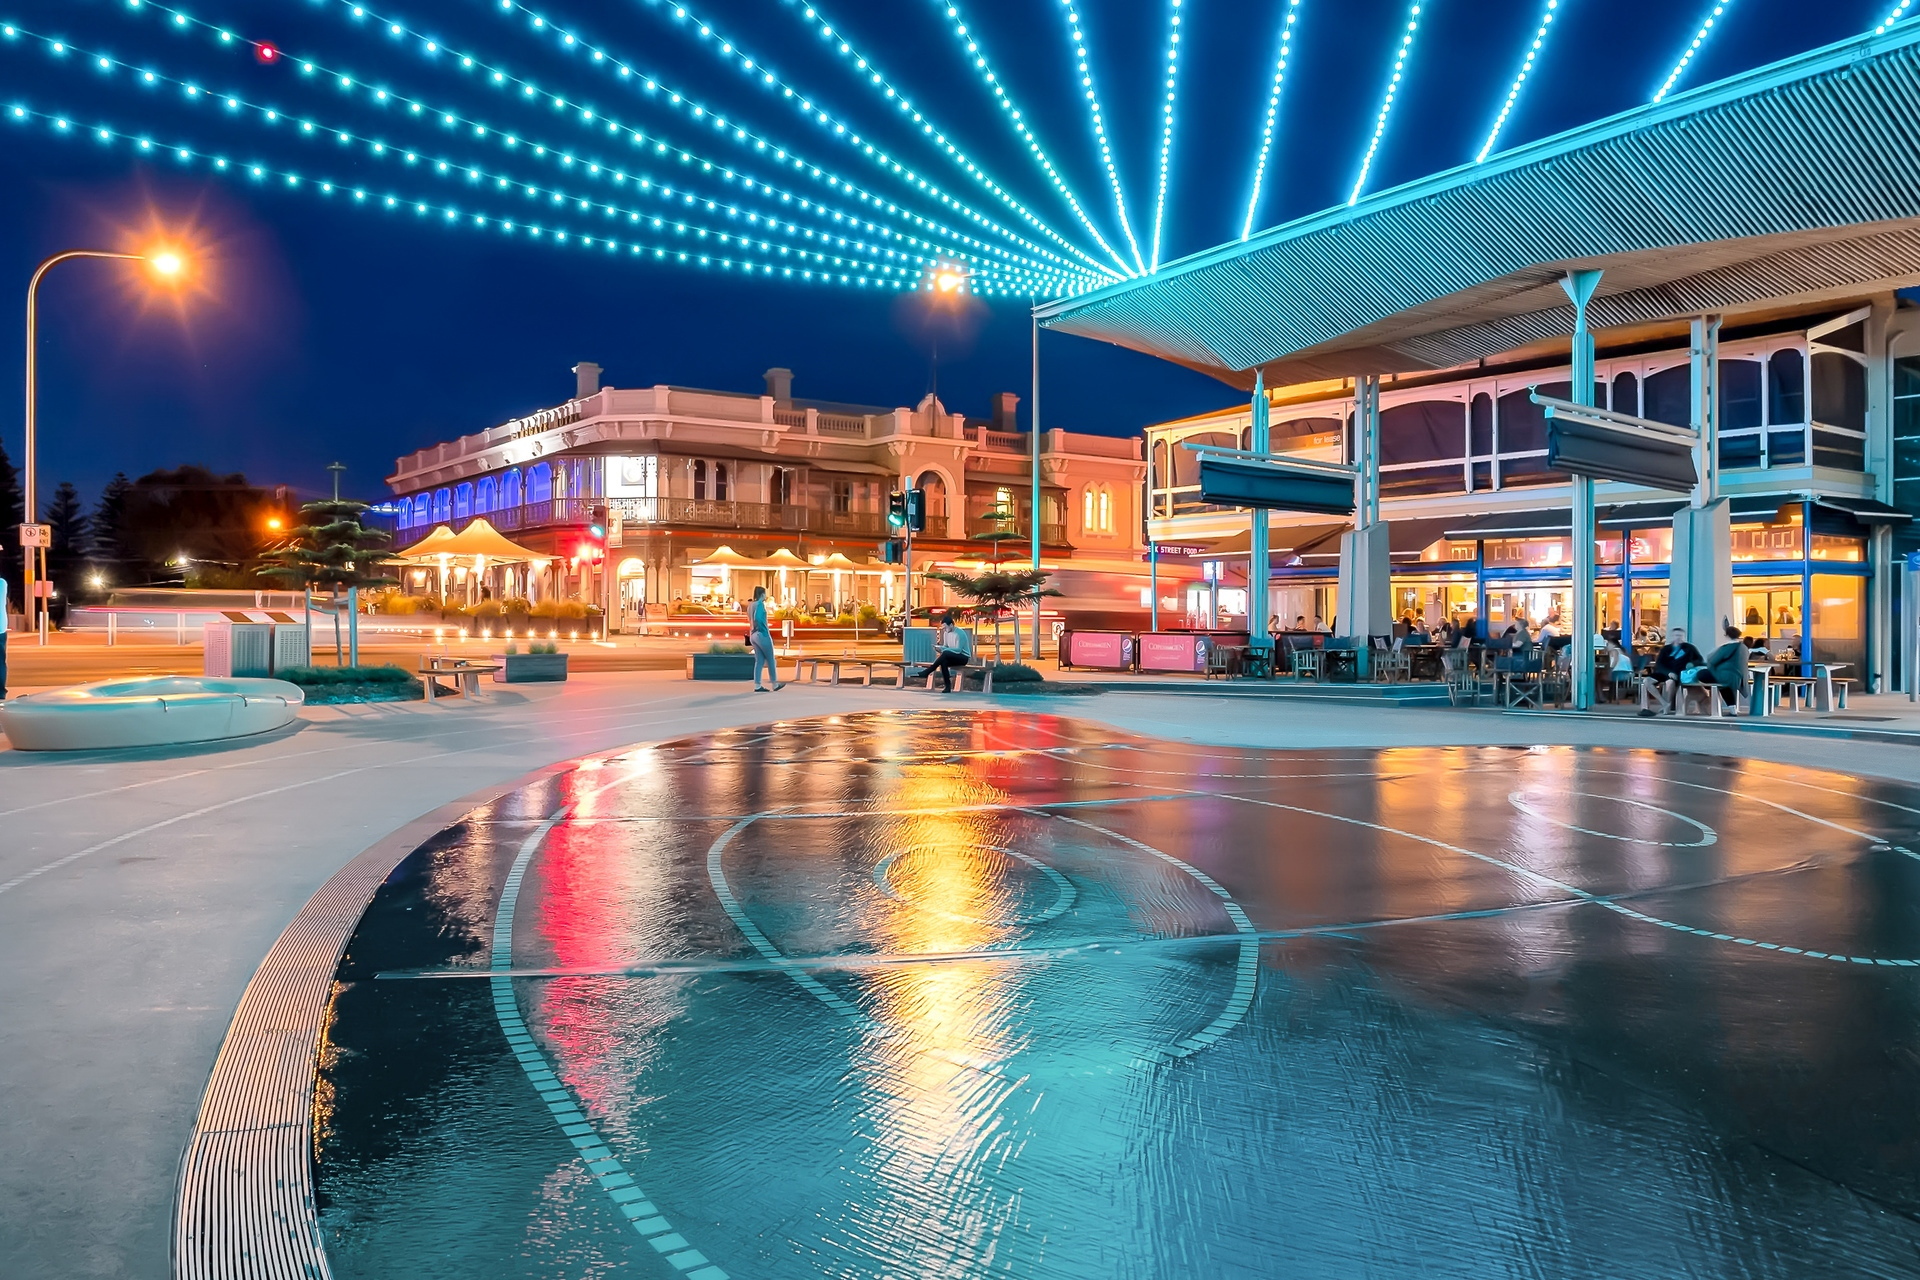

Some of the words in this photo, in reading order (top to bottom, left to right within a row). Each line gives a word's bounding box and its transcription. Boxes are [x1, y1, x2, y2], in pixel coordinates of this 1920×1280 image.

[1313, 436, 1324, 445] for
[1323, 434, 1341, 443] lease
[1160, 546, 1182, 555] STREET
[1183, 547, 1198, 555] FOOD
